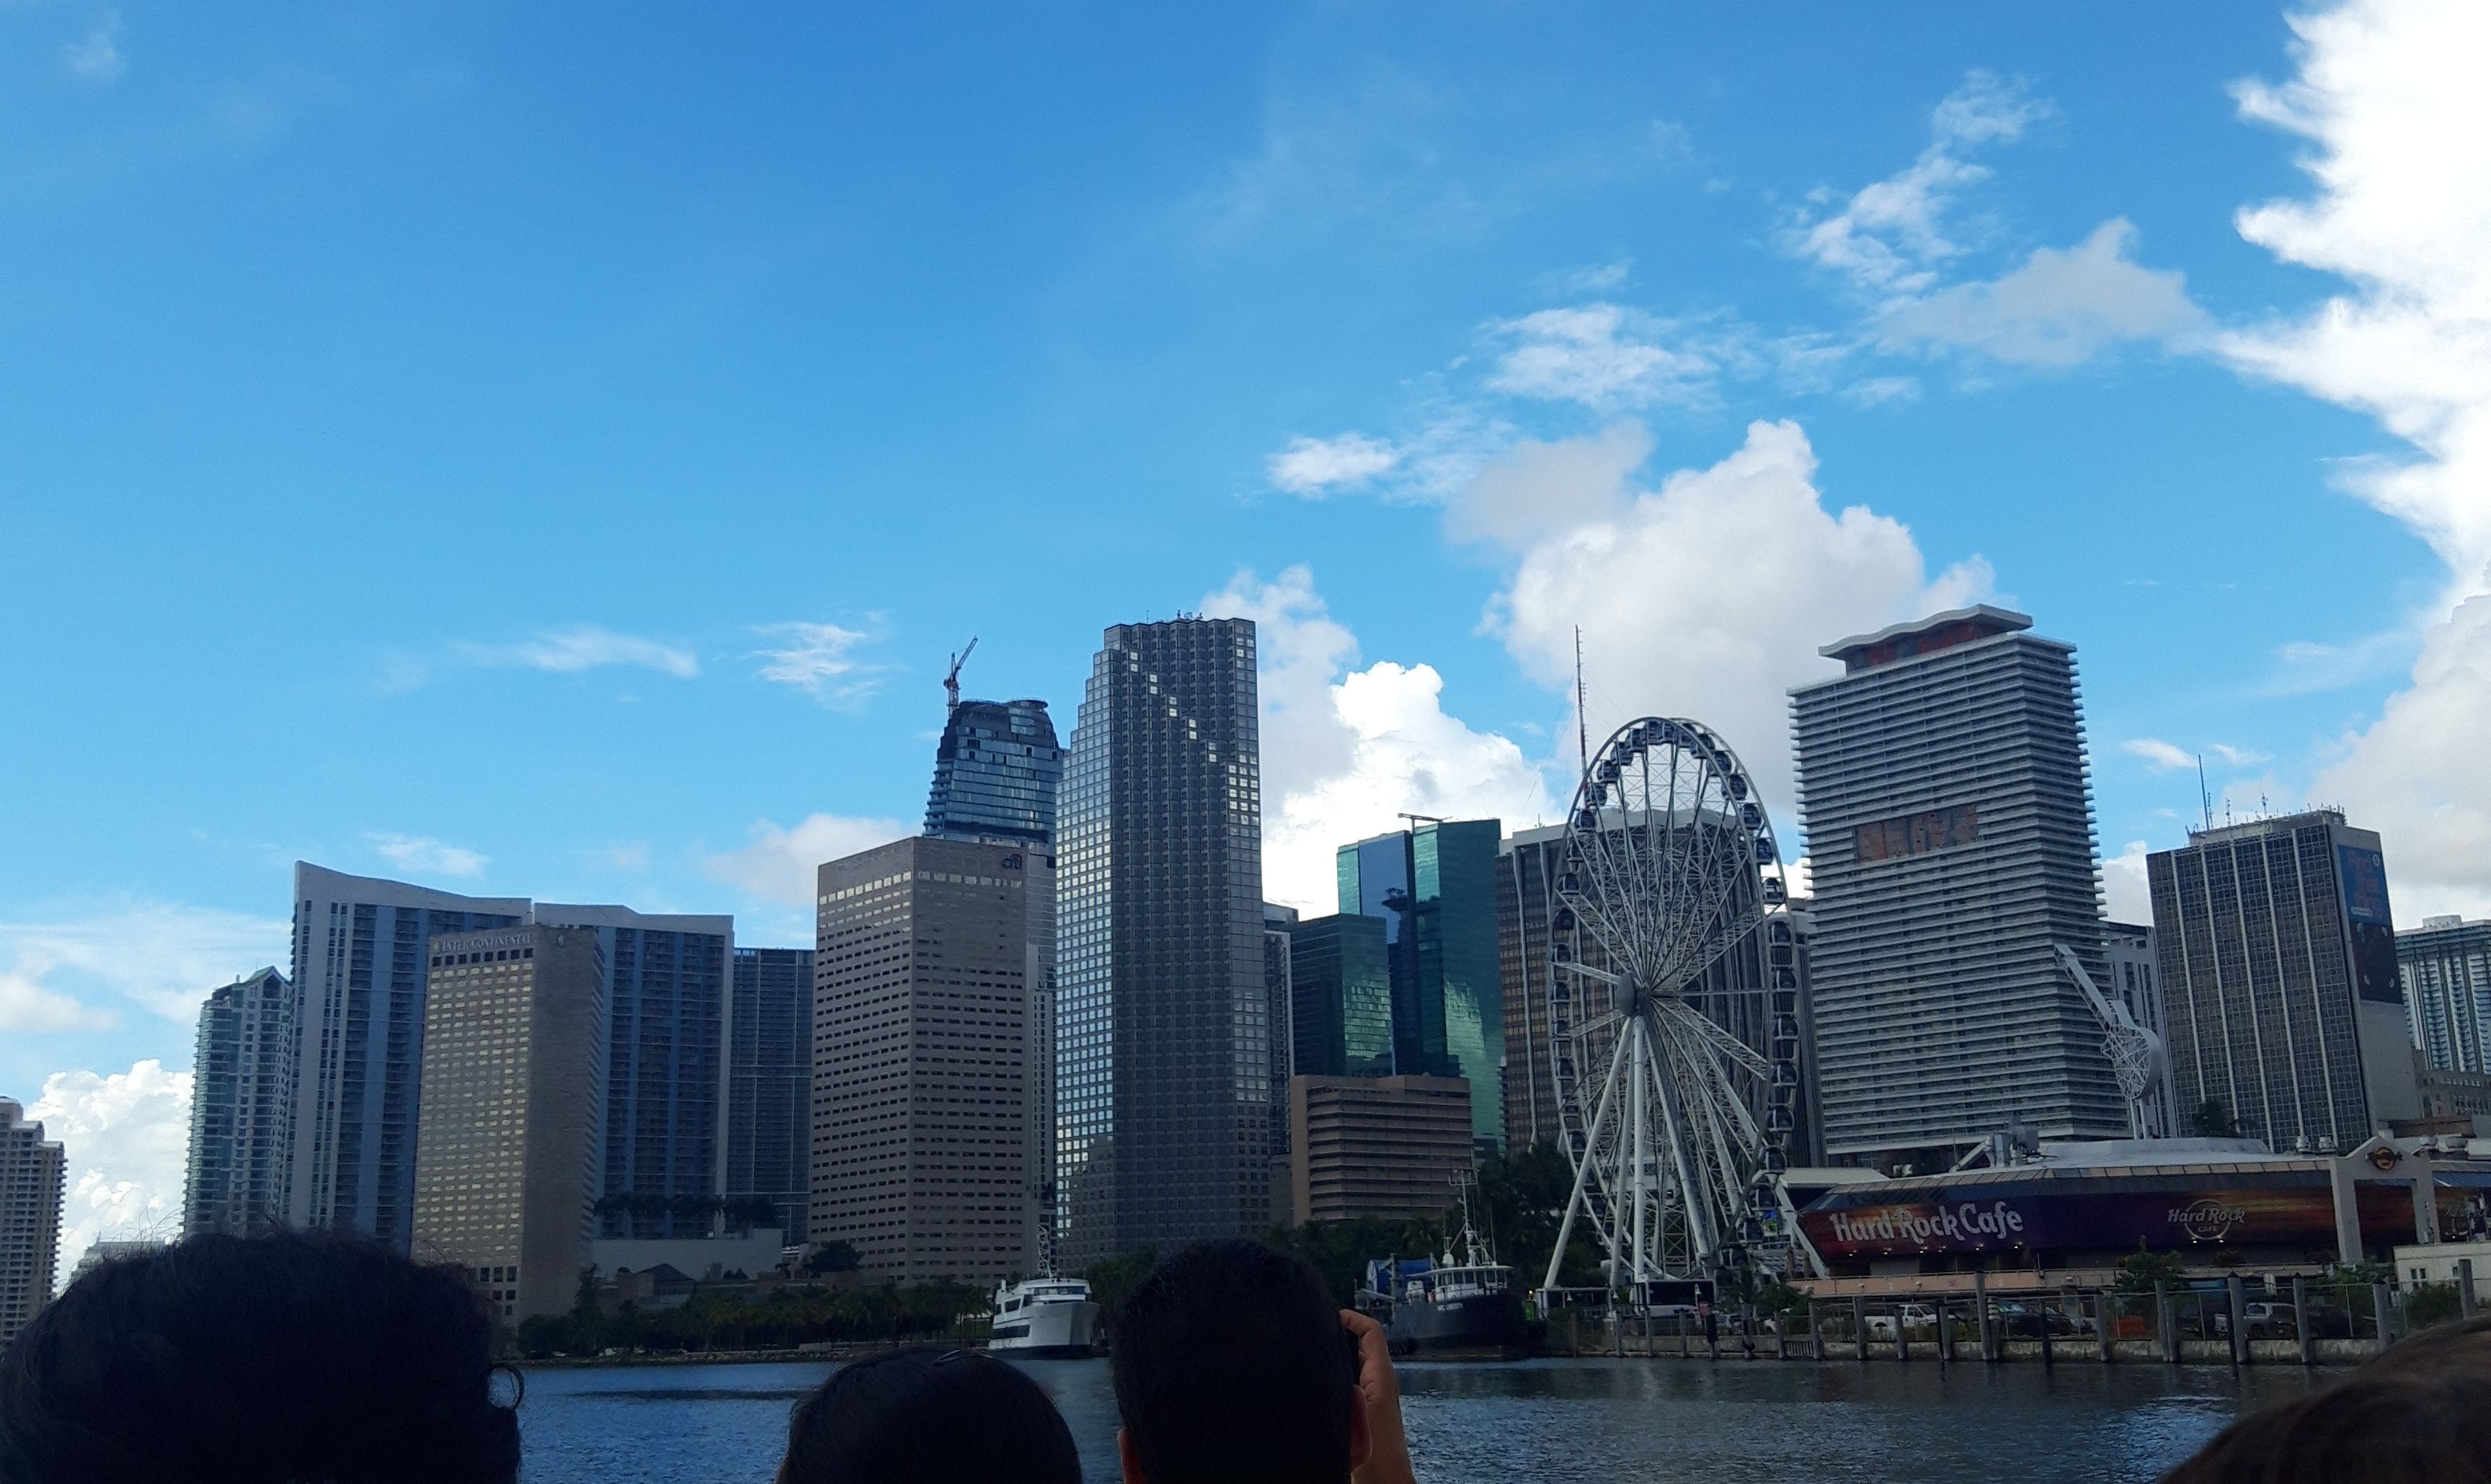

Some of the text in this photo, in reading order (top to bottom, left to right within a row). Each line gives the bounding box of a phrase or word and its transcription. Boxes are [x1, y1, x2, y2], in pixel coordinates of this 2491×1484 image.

[1830, 1201, 2024, 1243] Hard Rock Cafe
[2167, 1207, 2245, 1225] Hard Rock
